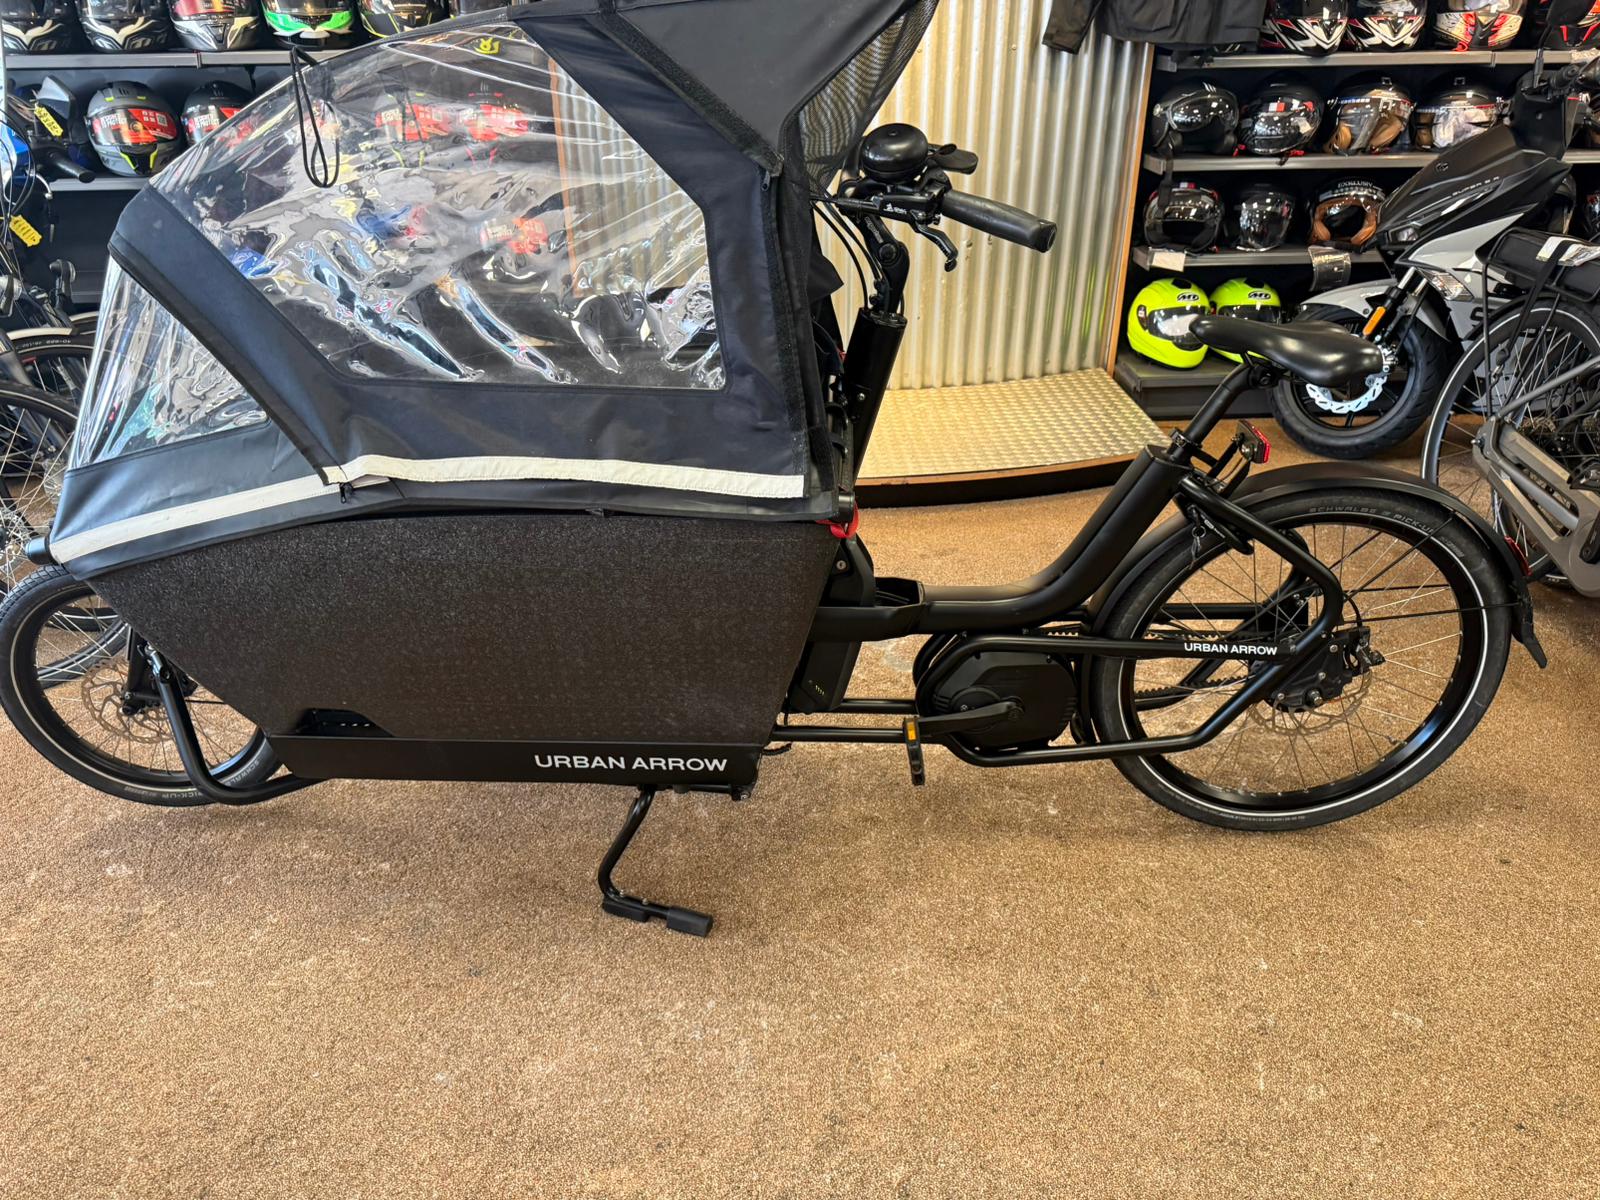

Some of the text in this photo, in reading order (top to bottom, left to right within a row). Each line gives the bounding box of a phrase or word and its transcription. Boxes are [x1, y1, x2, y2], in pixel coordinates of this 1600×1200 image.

[1184, 642, 1278, 656] URBAN ARROW
[534, 755, 728, 772] URBAN ARROW
